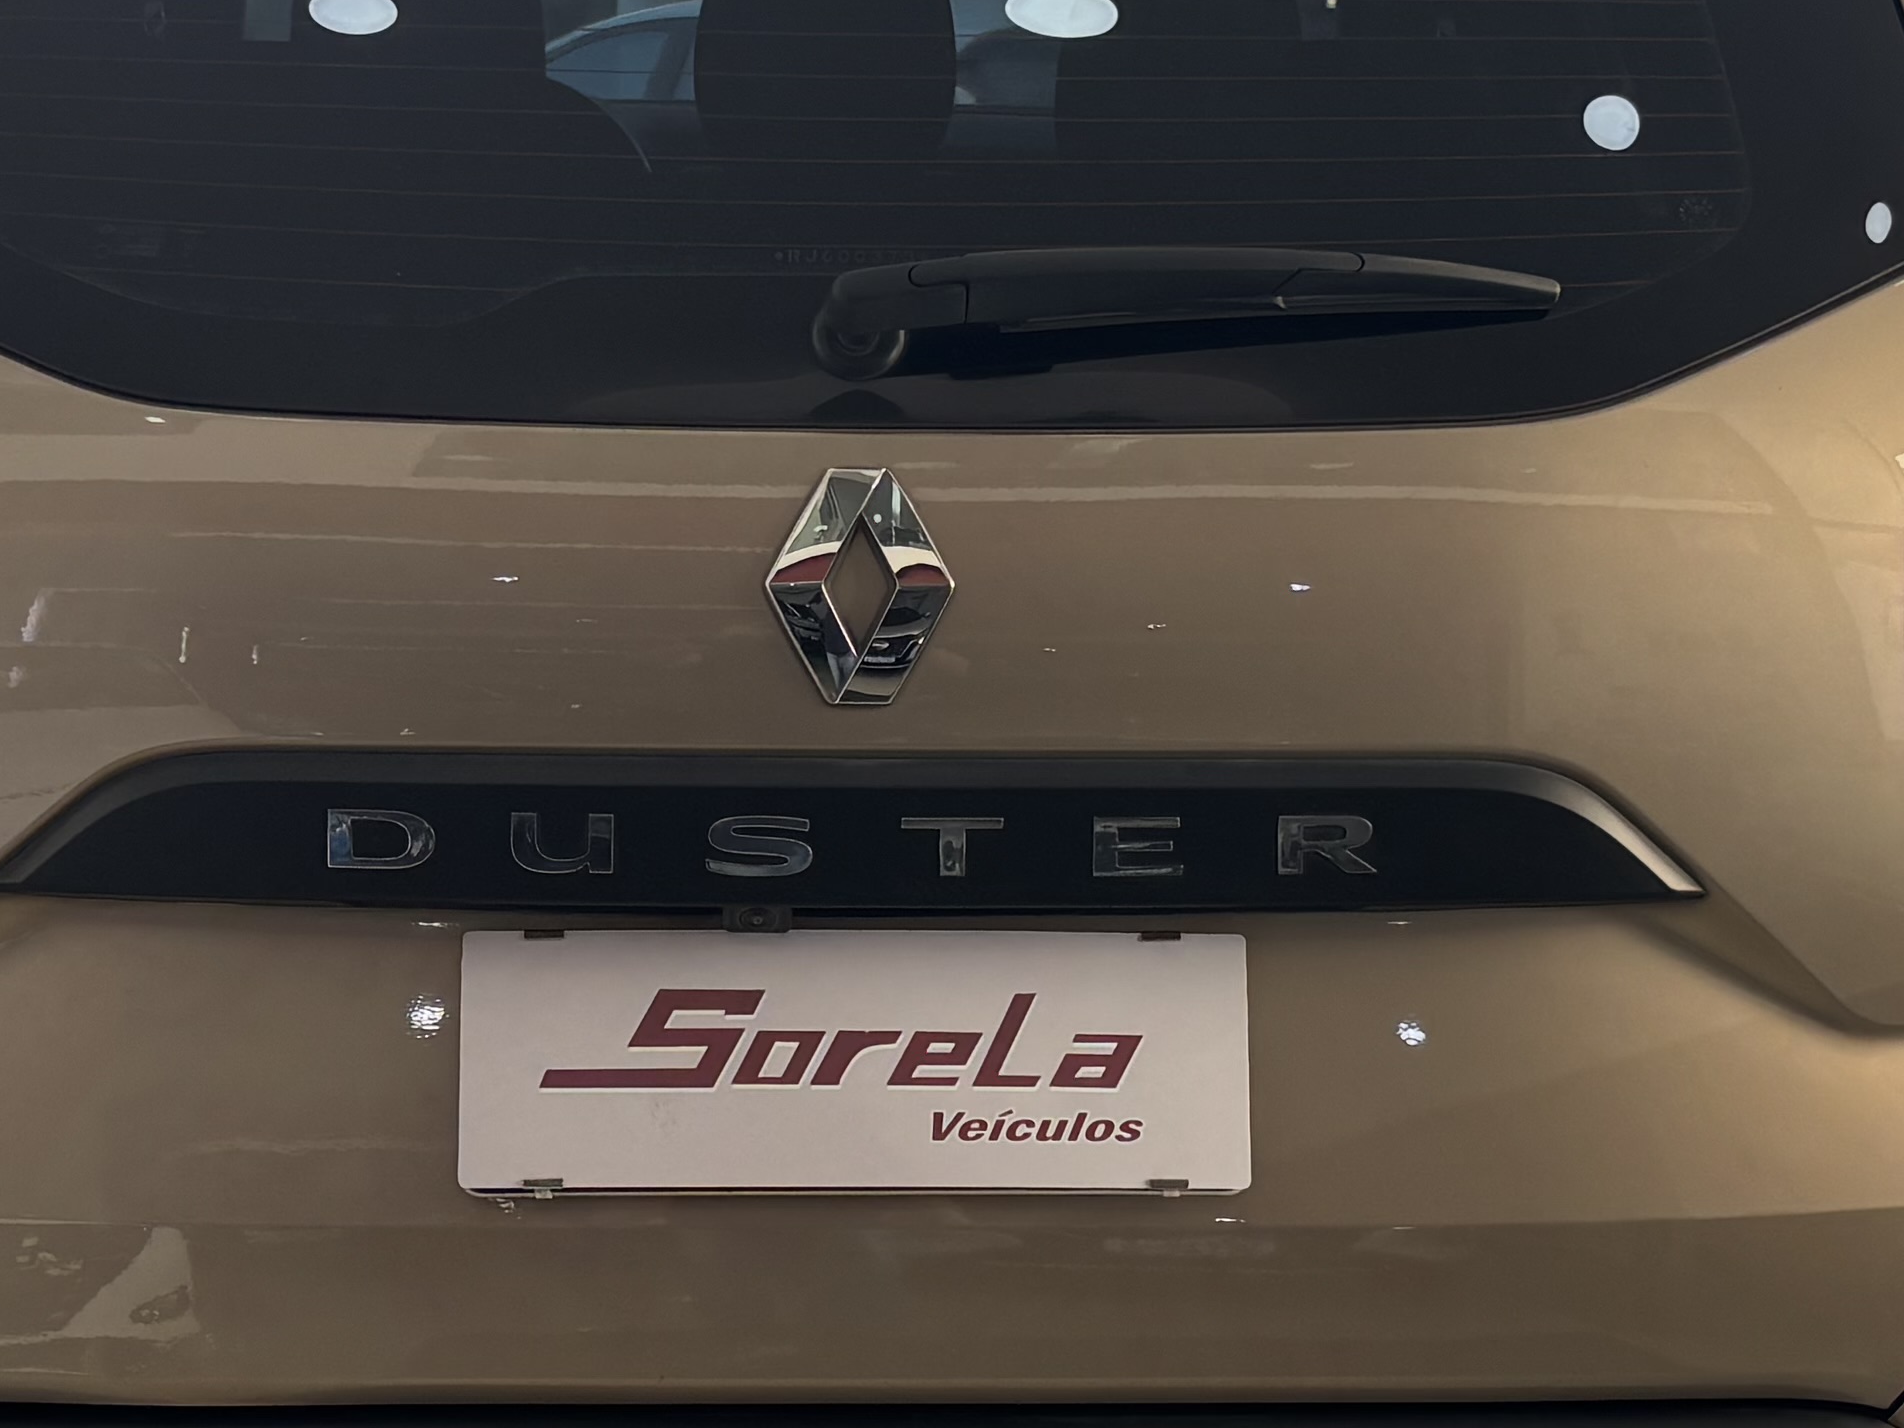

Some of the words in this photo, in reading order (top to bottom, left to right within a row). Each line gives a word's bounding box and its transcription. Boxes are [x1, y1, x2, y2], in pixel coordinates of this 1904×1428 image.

[326, 807, 1380, 877] DUSTER
[539, 987, 1145, 1091] SoreLa
[930, 1107, 1145, 1144] Veículos
